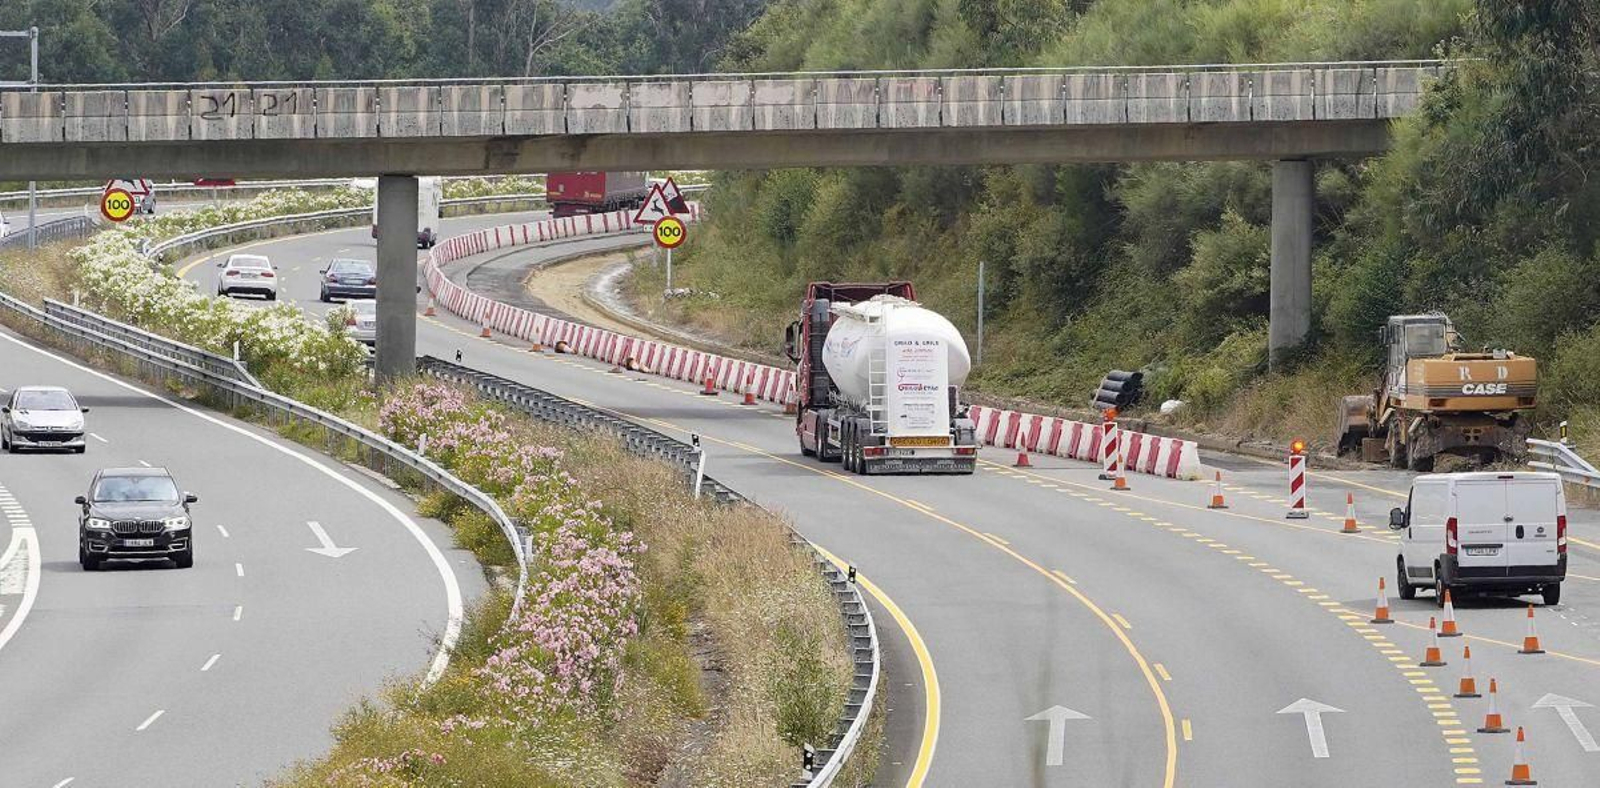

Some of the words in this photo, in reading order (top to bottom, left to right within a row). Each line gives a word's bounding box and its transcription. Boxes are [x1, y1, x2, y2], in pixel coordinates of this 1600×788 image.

[200, 92, 235, 120] 21
[263, 92, 297, 116] 21
[107, 199, 130, 210] 100
[658, 226, 681, 238] 100
[1458, 366, 1472, 381] R
[1496, 366, 1509, 381] D
[1461, 383, 1508, 395] CASE
